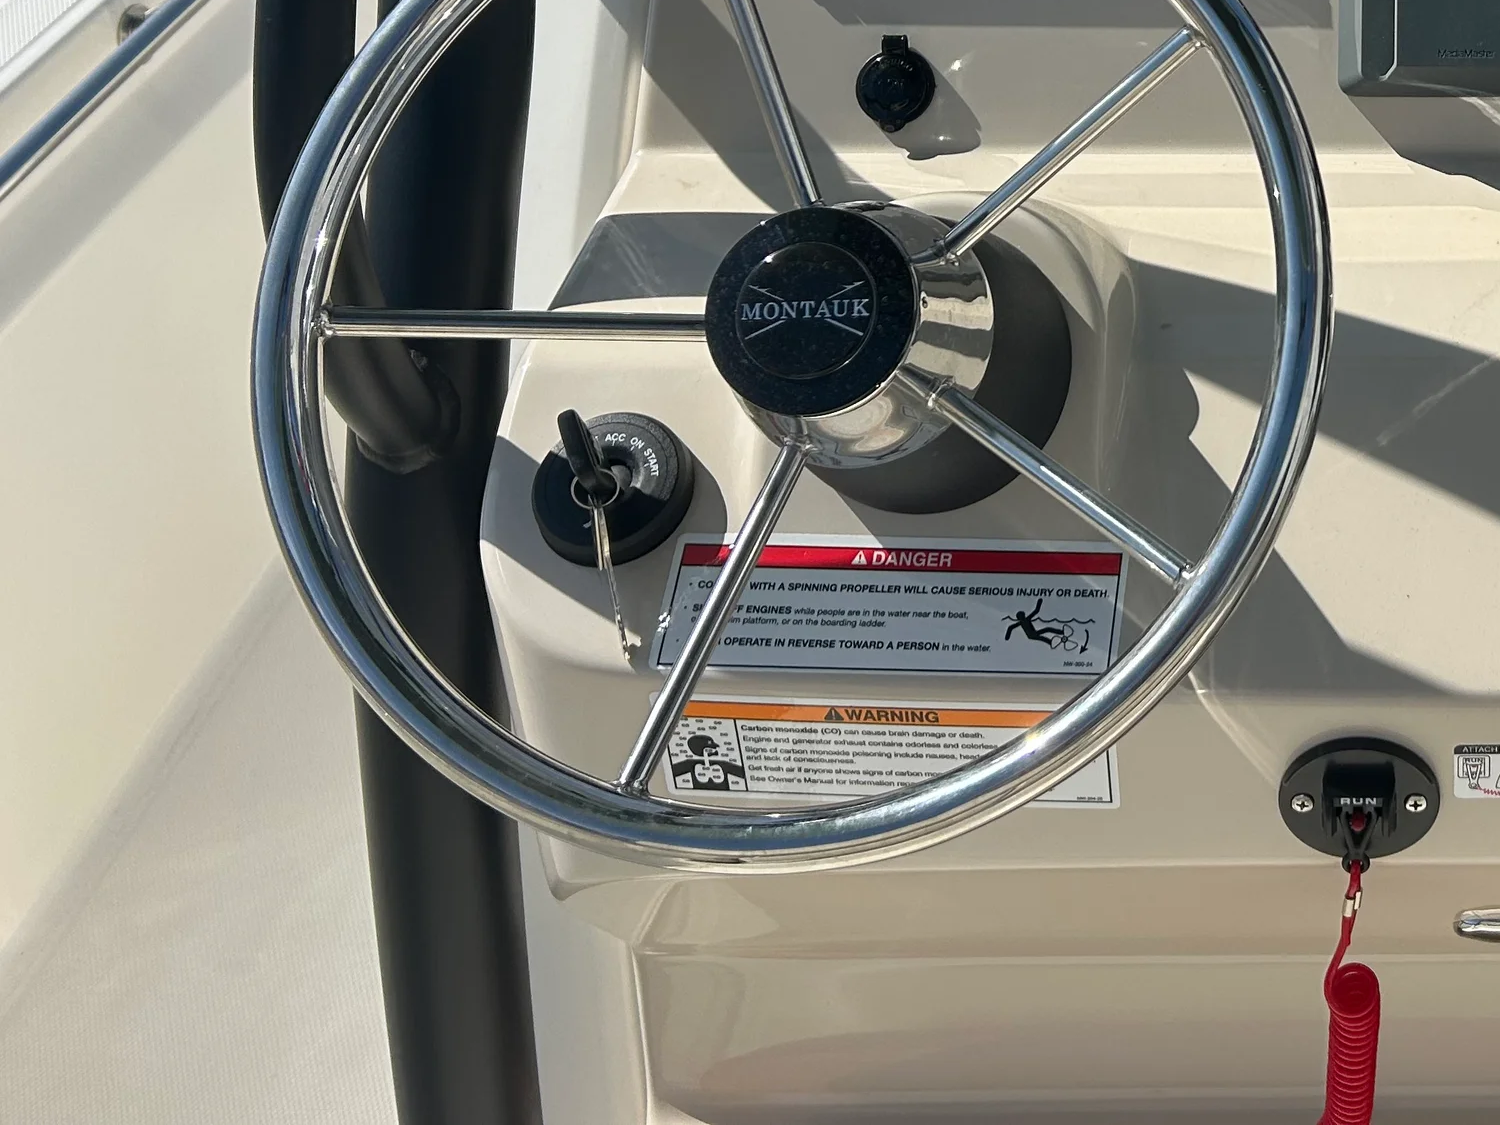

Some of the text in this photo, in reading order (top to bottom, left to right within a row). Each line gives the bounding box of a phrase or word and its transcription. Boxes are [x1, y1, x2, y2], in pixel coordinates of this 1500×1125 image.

[740, 298, 870, 321] MONTAUK
[604, 433, 659, 477] ACC ON START
[872, 550, 952, 567] DANGER
[750, 582, 1110, 598] WITH A SPINNING PROPELLER WILL CAUSE SERIOUS INJURY OR DEATH.
[746, 605, 792, 615] ENGINES
[794, 608, 815, 616] while
[817, 609, 845, 618] people
[863, 609, 870, 617] in
[932, 611, 946, 619] the
[948, 611, 969, 620] boat,
[742, 616, 779, 626] platform,
[820, 618, 857, 628] boarding
[859, 619, 886, 627] ladder.
[723, 637, 772, 647] OPERATE
[774, 638, 784, 647] IN
[788, 639, 836, 648] REVERSE
[838, 640, 884, 649] TOWARD
[886, 641, 894, 649] A
[896, 641, 940, 650] PERSON
[844, 709, 939, 723] WARNING
[741, 724, 773, 732] Carbon
[775, 726, 818, 734] monoxide
[821, 727, 841, 736] (CO)
[912, 731, 946, 739] damage
[743, 735, 772, 743] Engine
[792, 738, 831, 746] generator
[745, 746, 768, 754] Signs
[852, 750, 892, 759] poisoning
[849, 779, 895, 787] information
[1340, 797, 1377, 805] RUN
